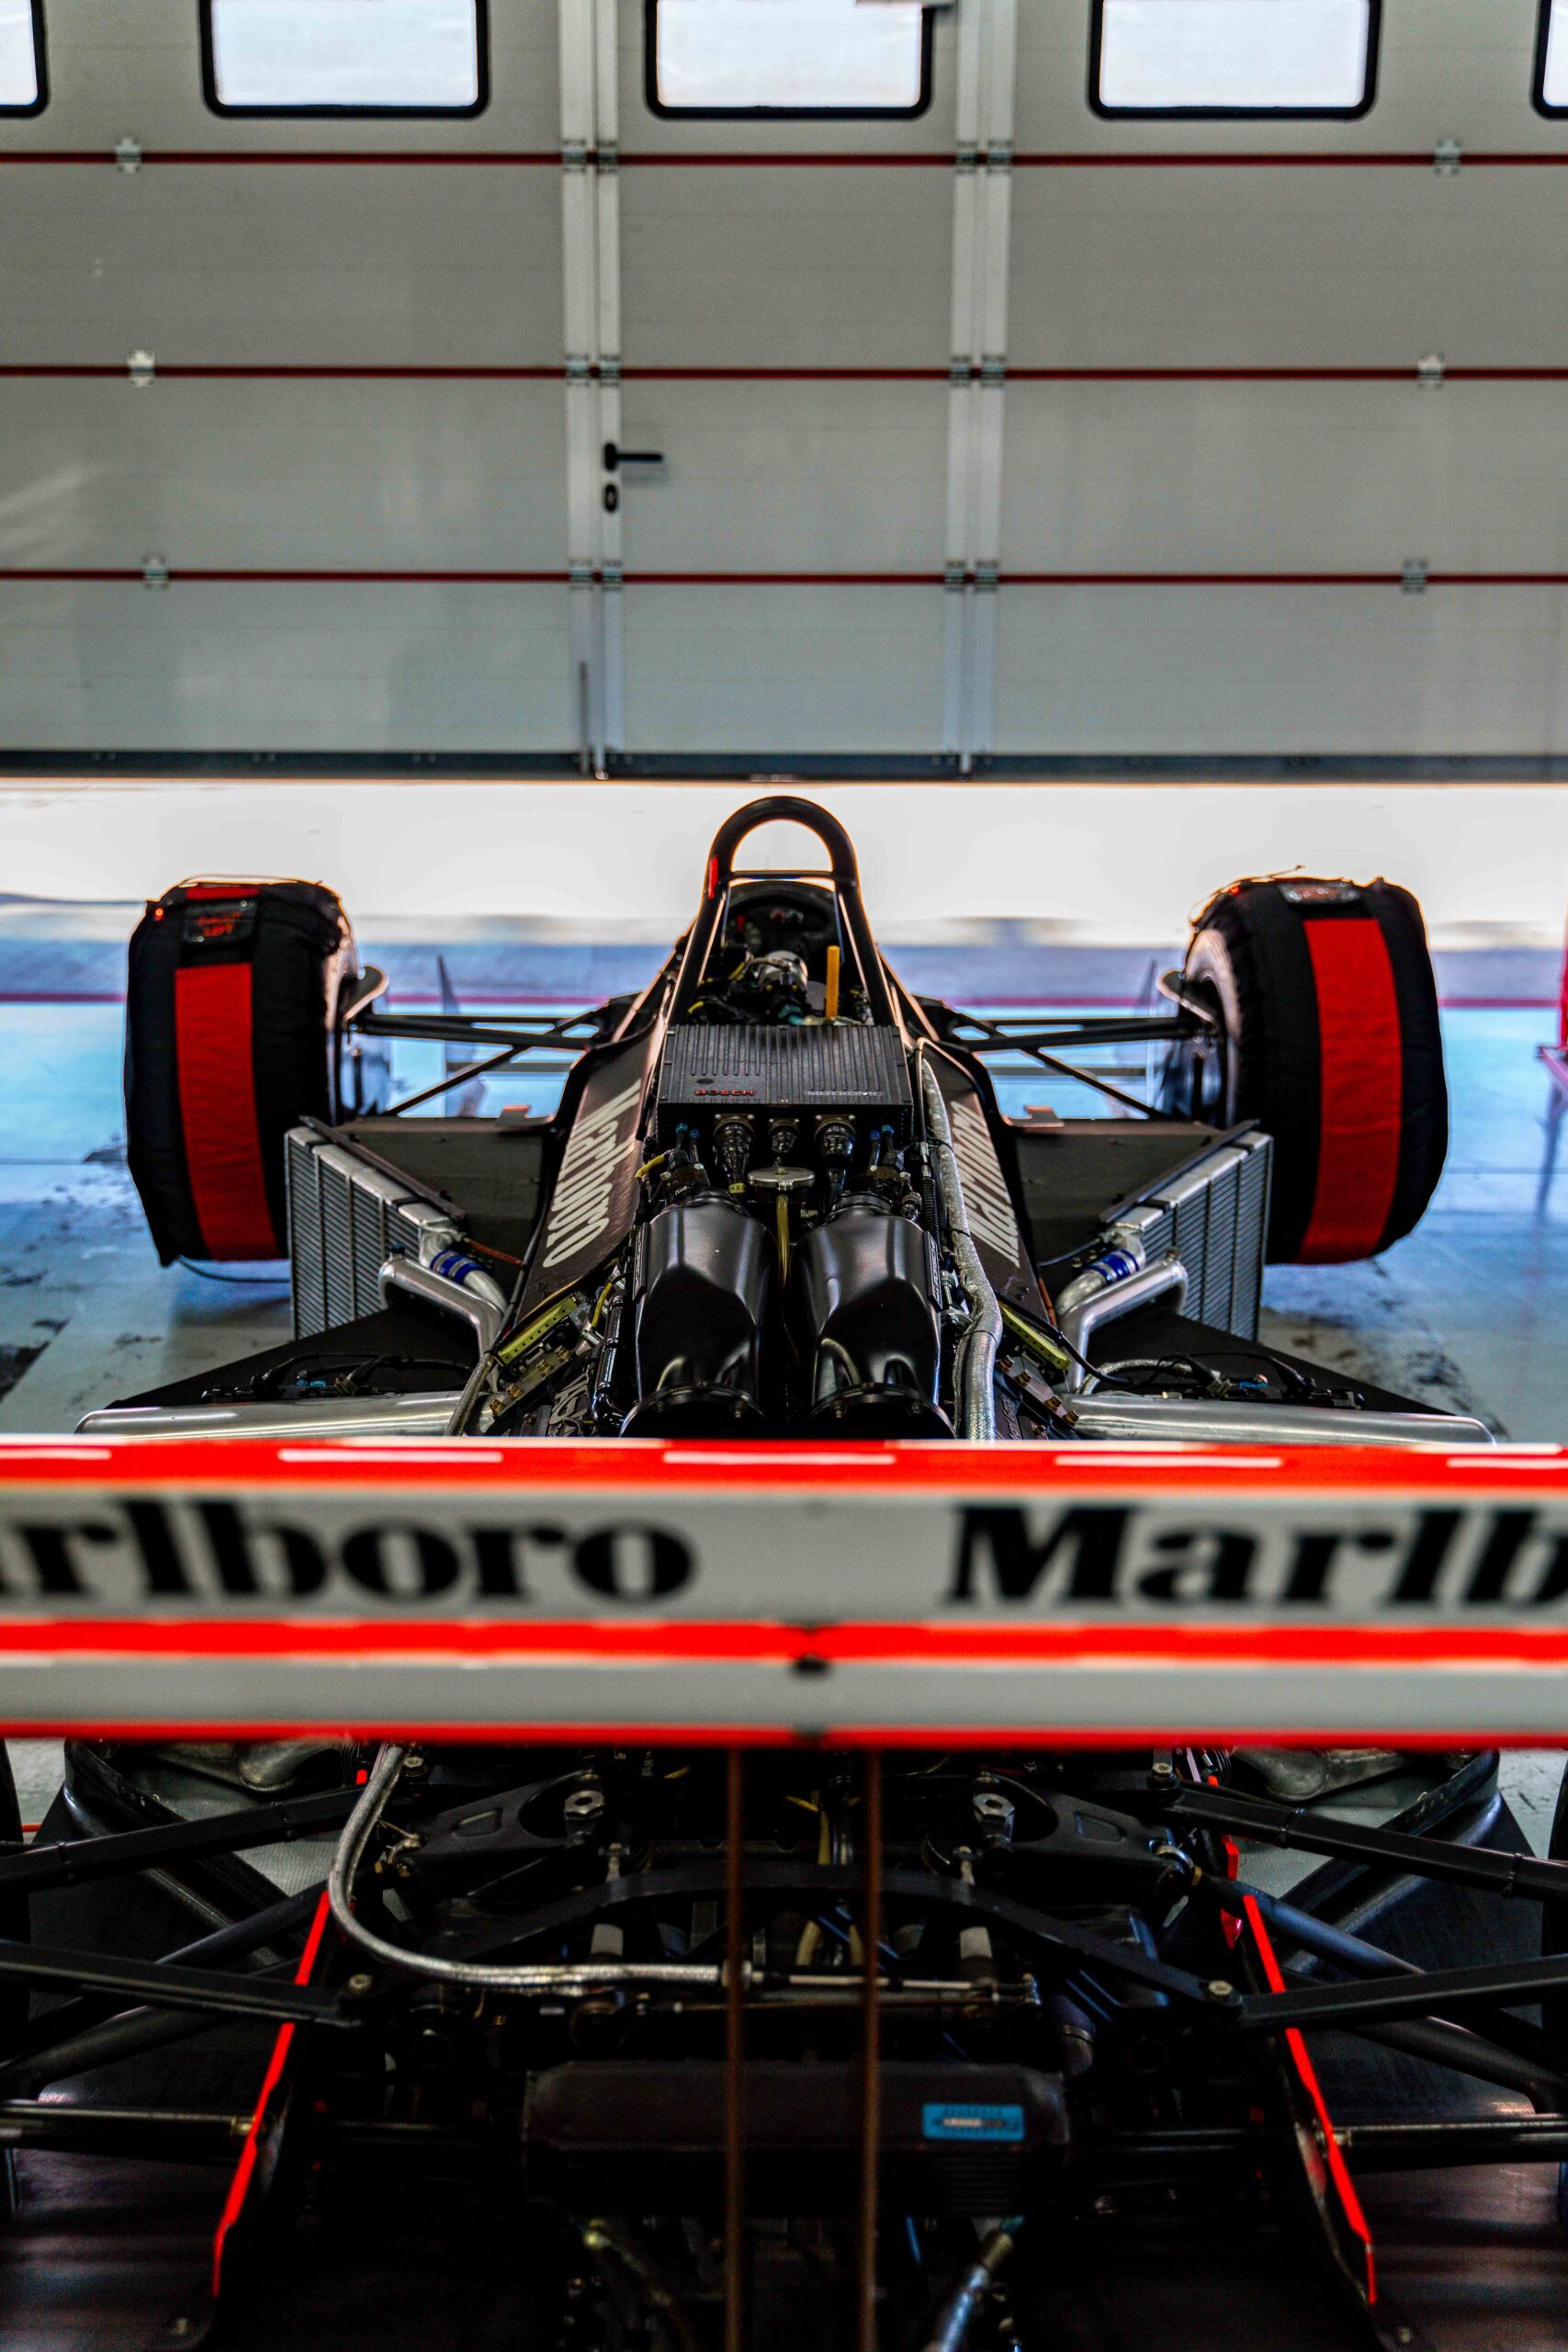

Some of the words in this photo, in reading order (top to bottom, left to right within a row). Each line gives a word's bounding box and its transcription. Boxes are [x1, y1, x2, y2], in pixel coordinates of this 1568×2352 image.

[542, 1079, 641, 1268] Marlboro
[951, 1102, 1021, 1269] Marlboro
[0, 1496, 700, 1603] rlboro
